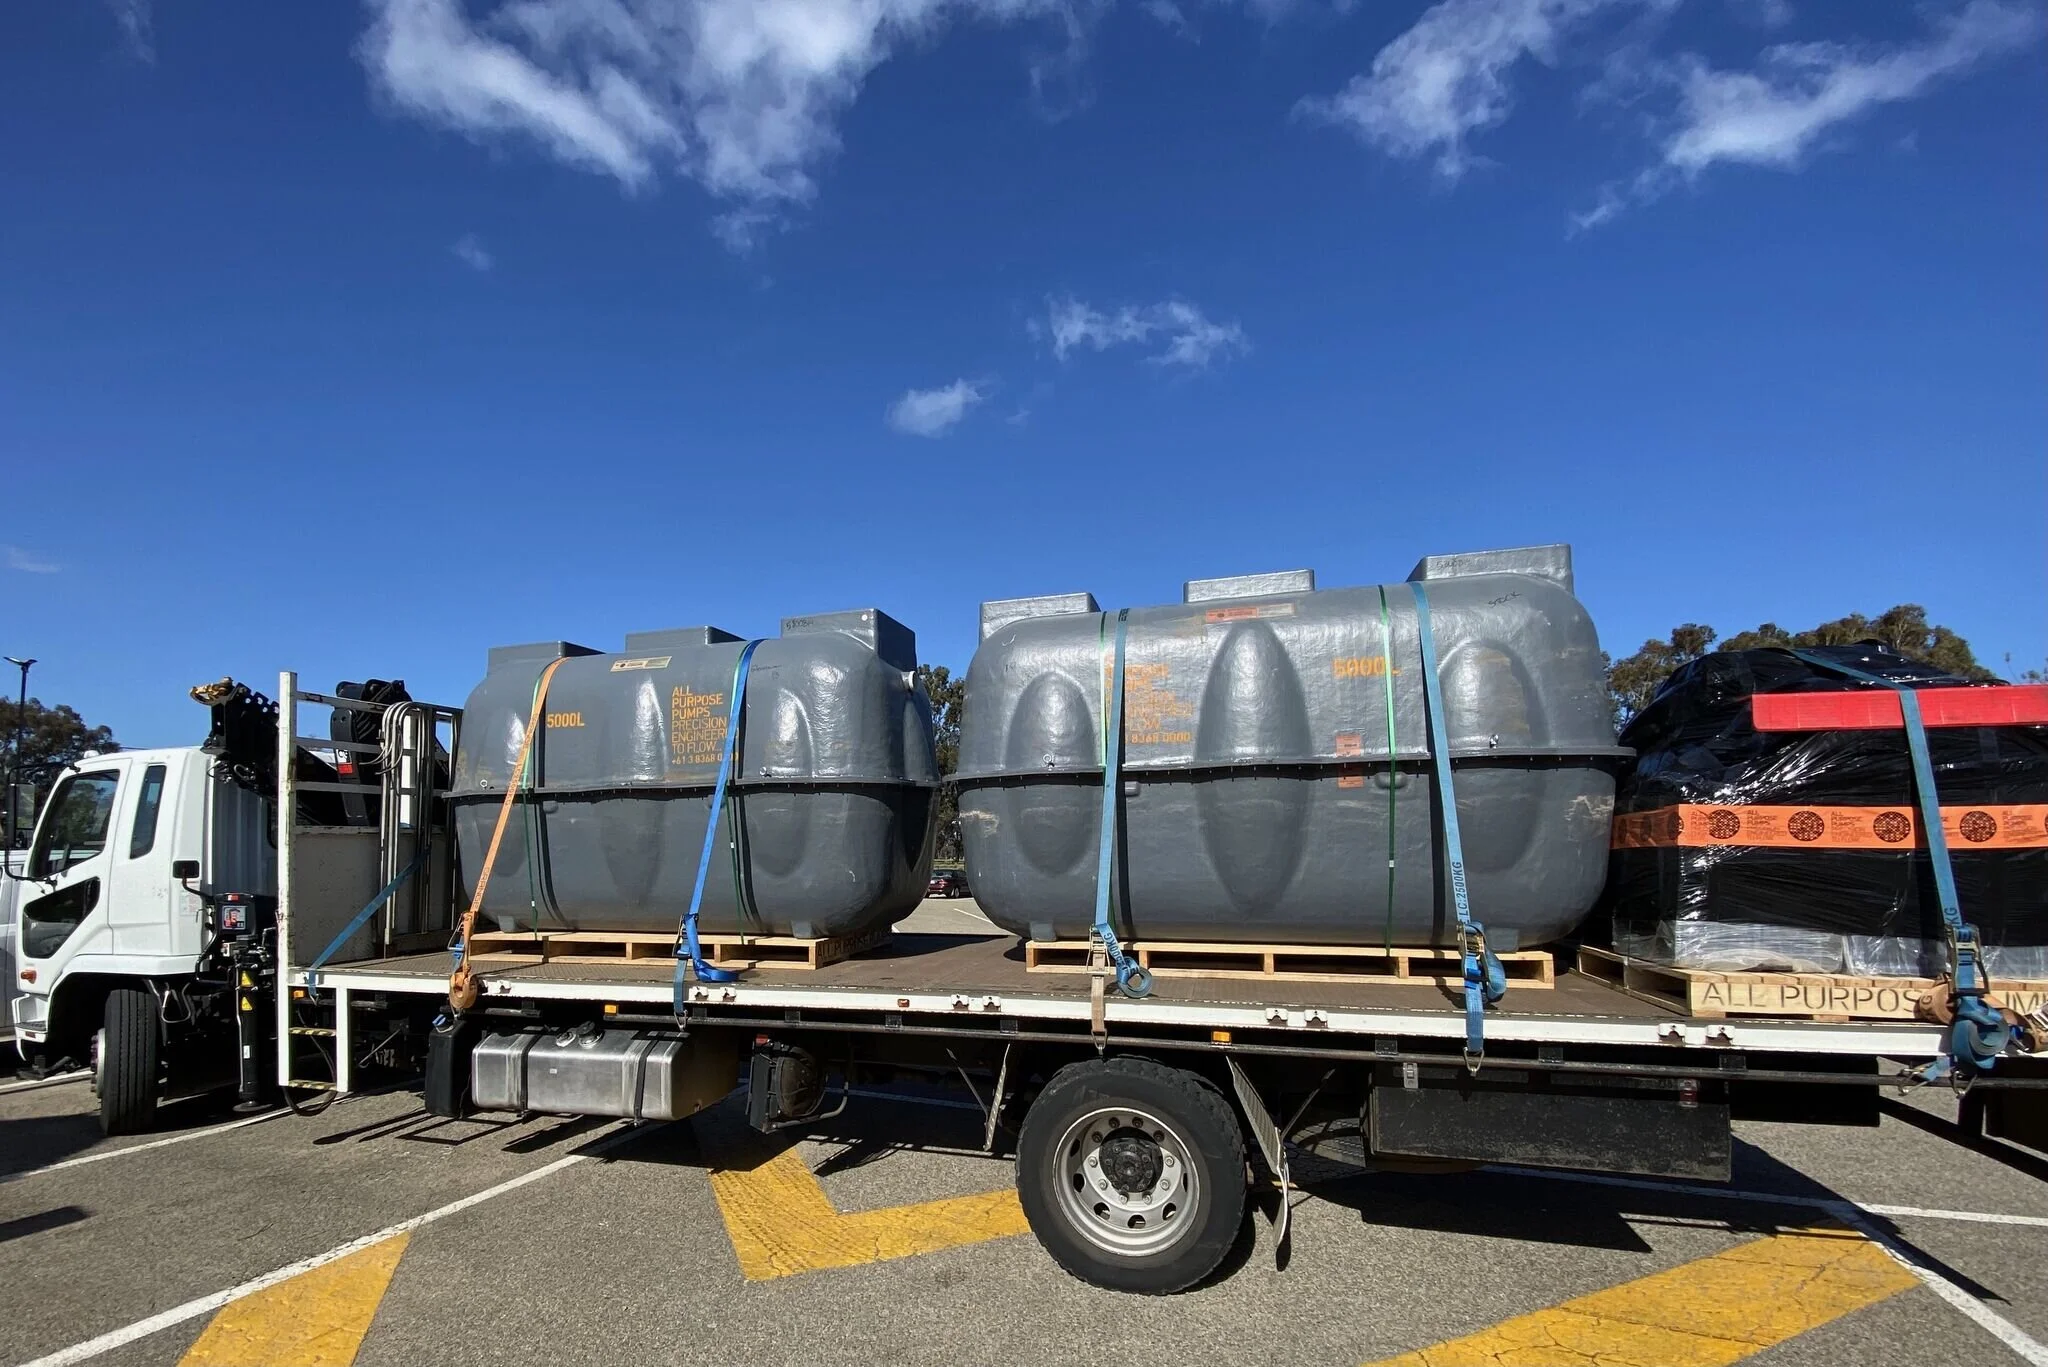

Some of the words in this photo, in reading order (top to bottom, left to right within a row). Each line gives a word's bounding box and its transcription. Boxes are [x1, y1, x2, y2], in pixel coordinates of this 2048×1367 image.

[672, 685, 693, 697] ALL
[672, 693, 723, 708] PURPOSE
[547, 712, 585, 729] 5000L
[672, 706, 711, 720] PUMPS
[672, 716, 728, 731] PRECISION
[672, 727, 740, 743] ENGINEER
[672, 743, 685, 754] TO
[695, 753, 716, 764] 8368
[1452, 861, 1469, 916] LC:2500KG
[1701, 982, 1766, 1008] ALL
[1779, 985, 1923, 1013] PURPOS
